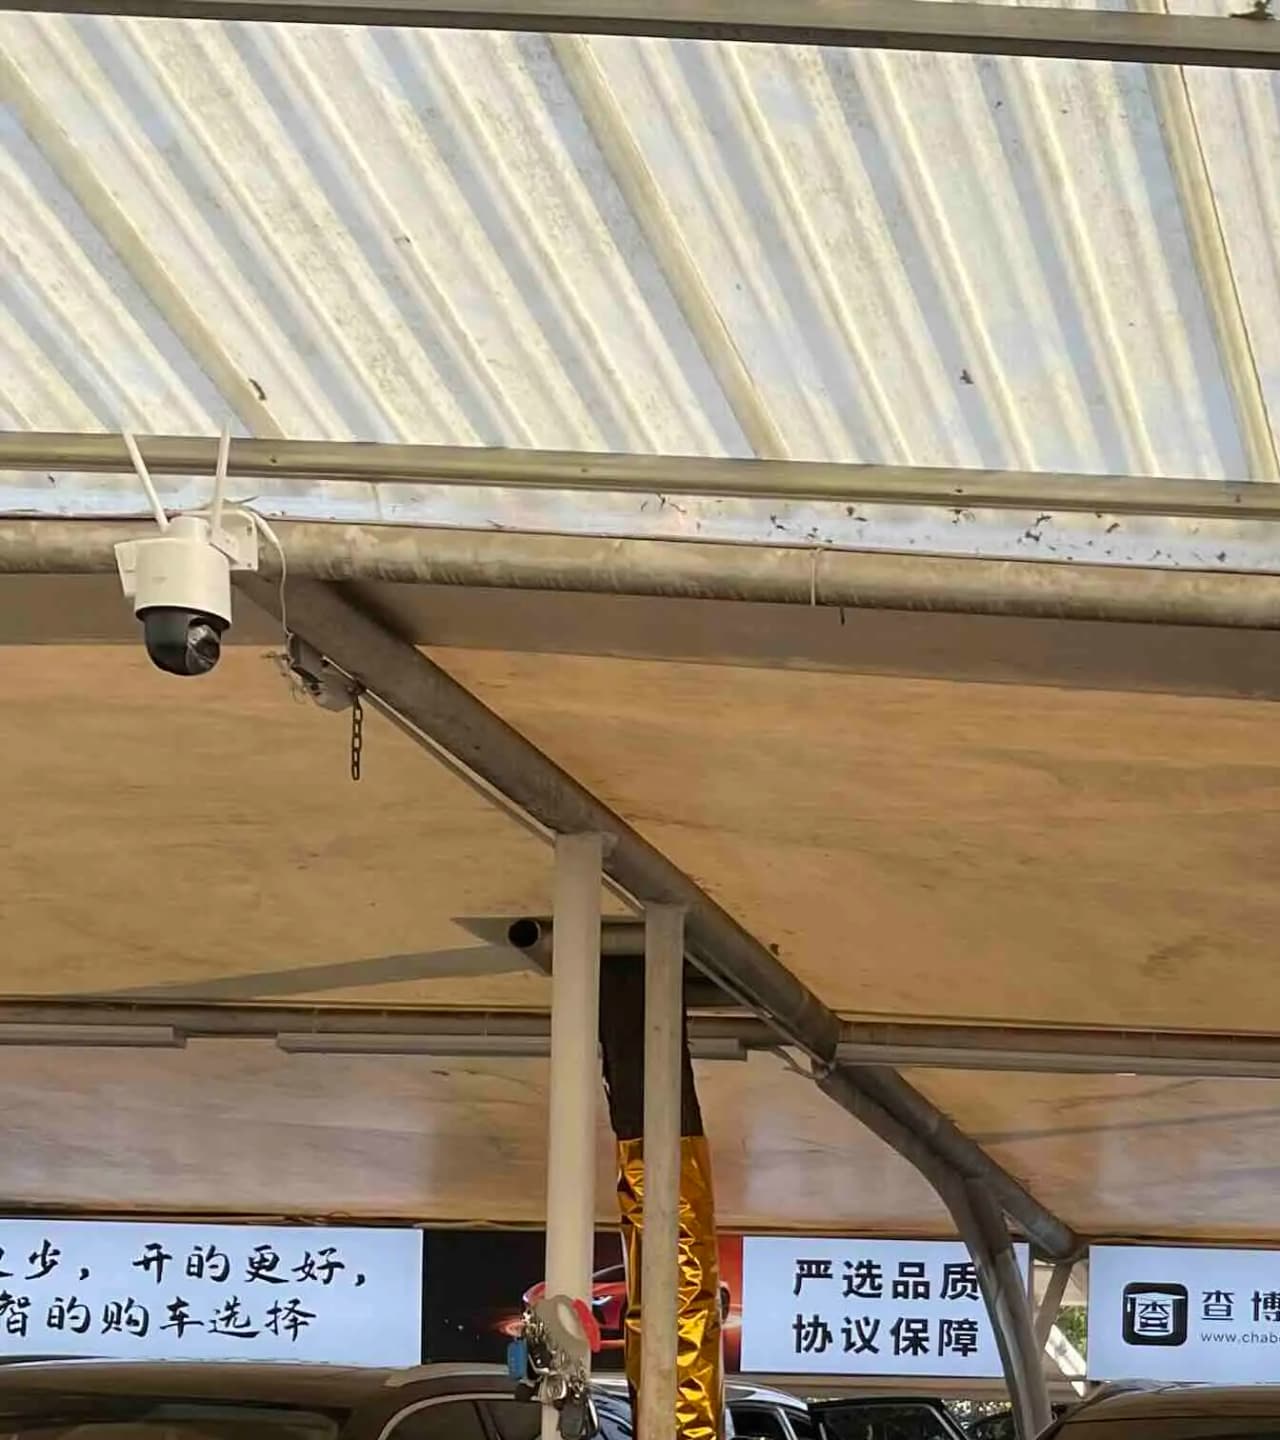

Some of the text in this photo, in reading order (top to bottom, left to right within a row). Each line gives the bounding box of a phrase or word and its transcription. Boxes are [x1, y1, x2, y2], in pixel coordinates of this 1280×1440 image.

[793, 1259, 979, 1301] 严选品质
[792, 1315, 978, 1357] 协议保障
